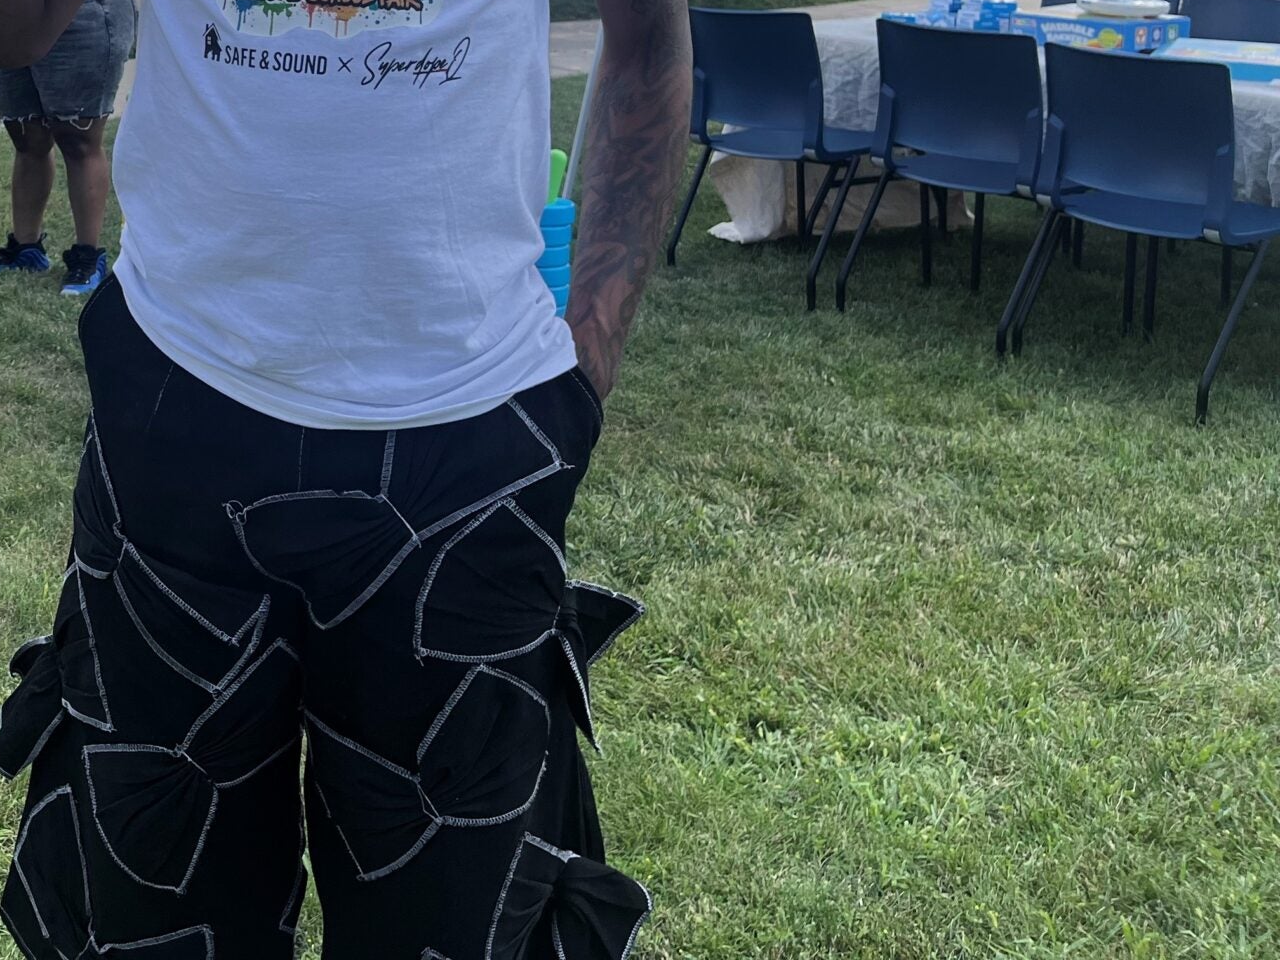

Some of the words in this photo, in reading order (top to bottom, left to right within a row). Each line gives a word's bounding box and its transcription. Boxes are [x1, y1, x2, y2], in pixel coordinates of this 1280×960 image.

[224, 45, 257, 68] SAFE
[259, 50, 269, 70] &
[272, 51, 328, 75] SOUND
